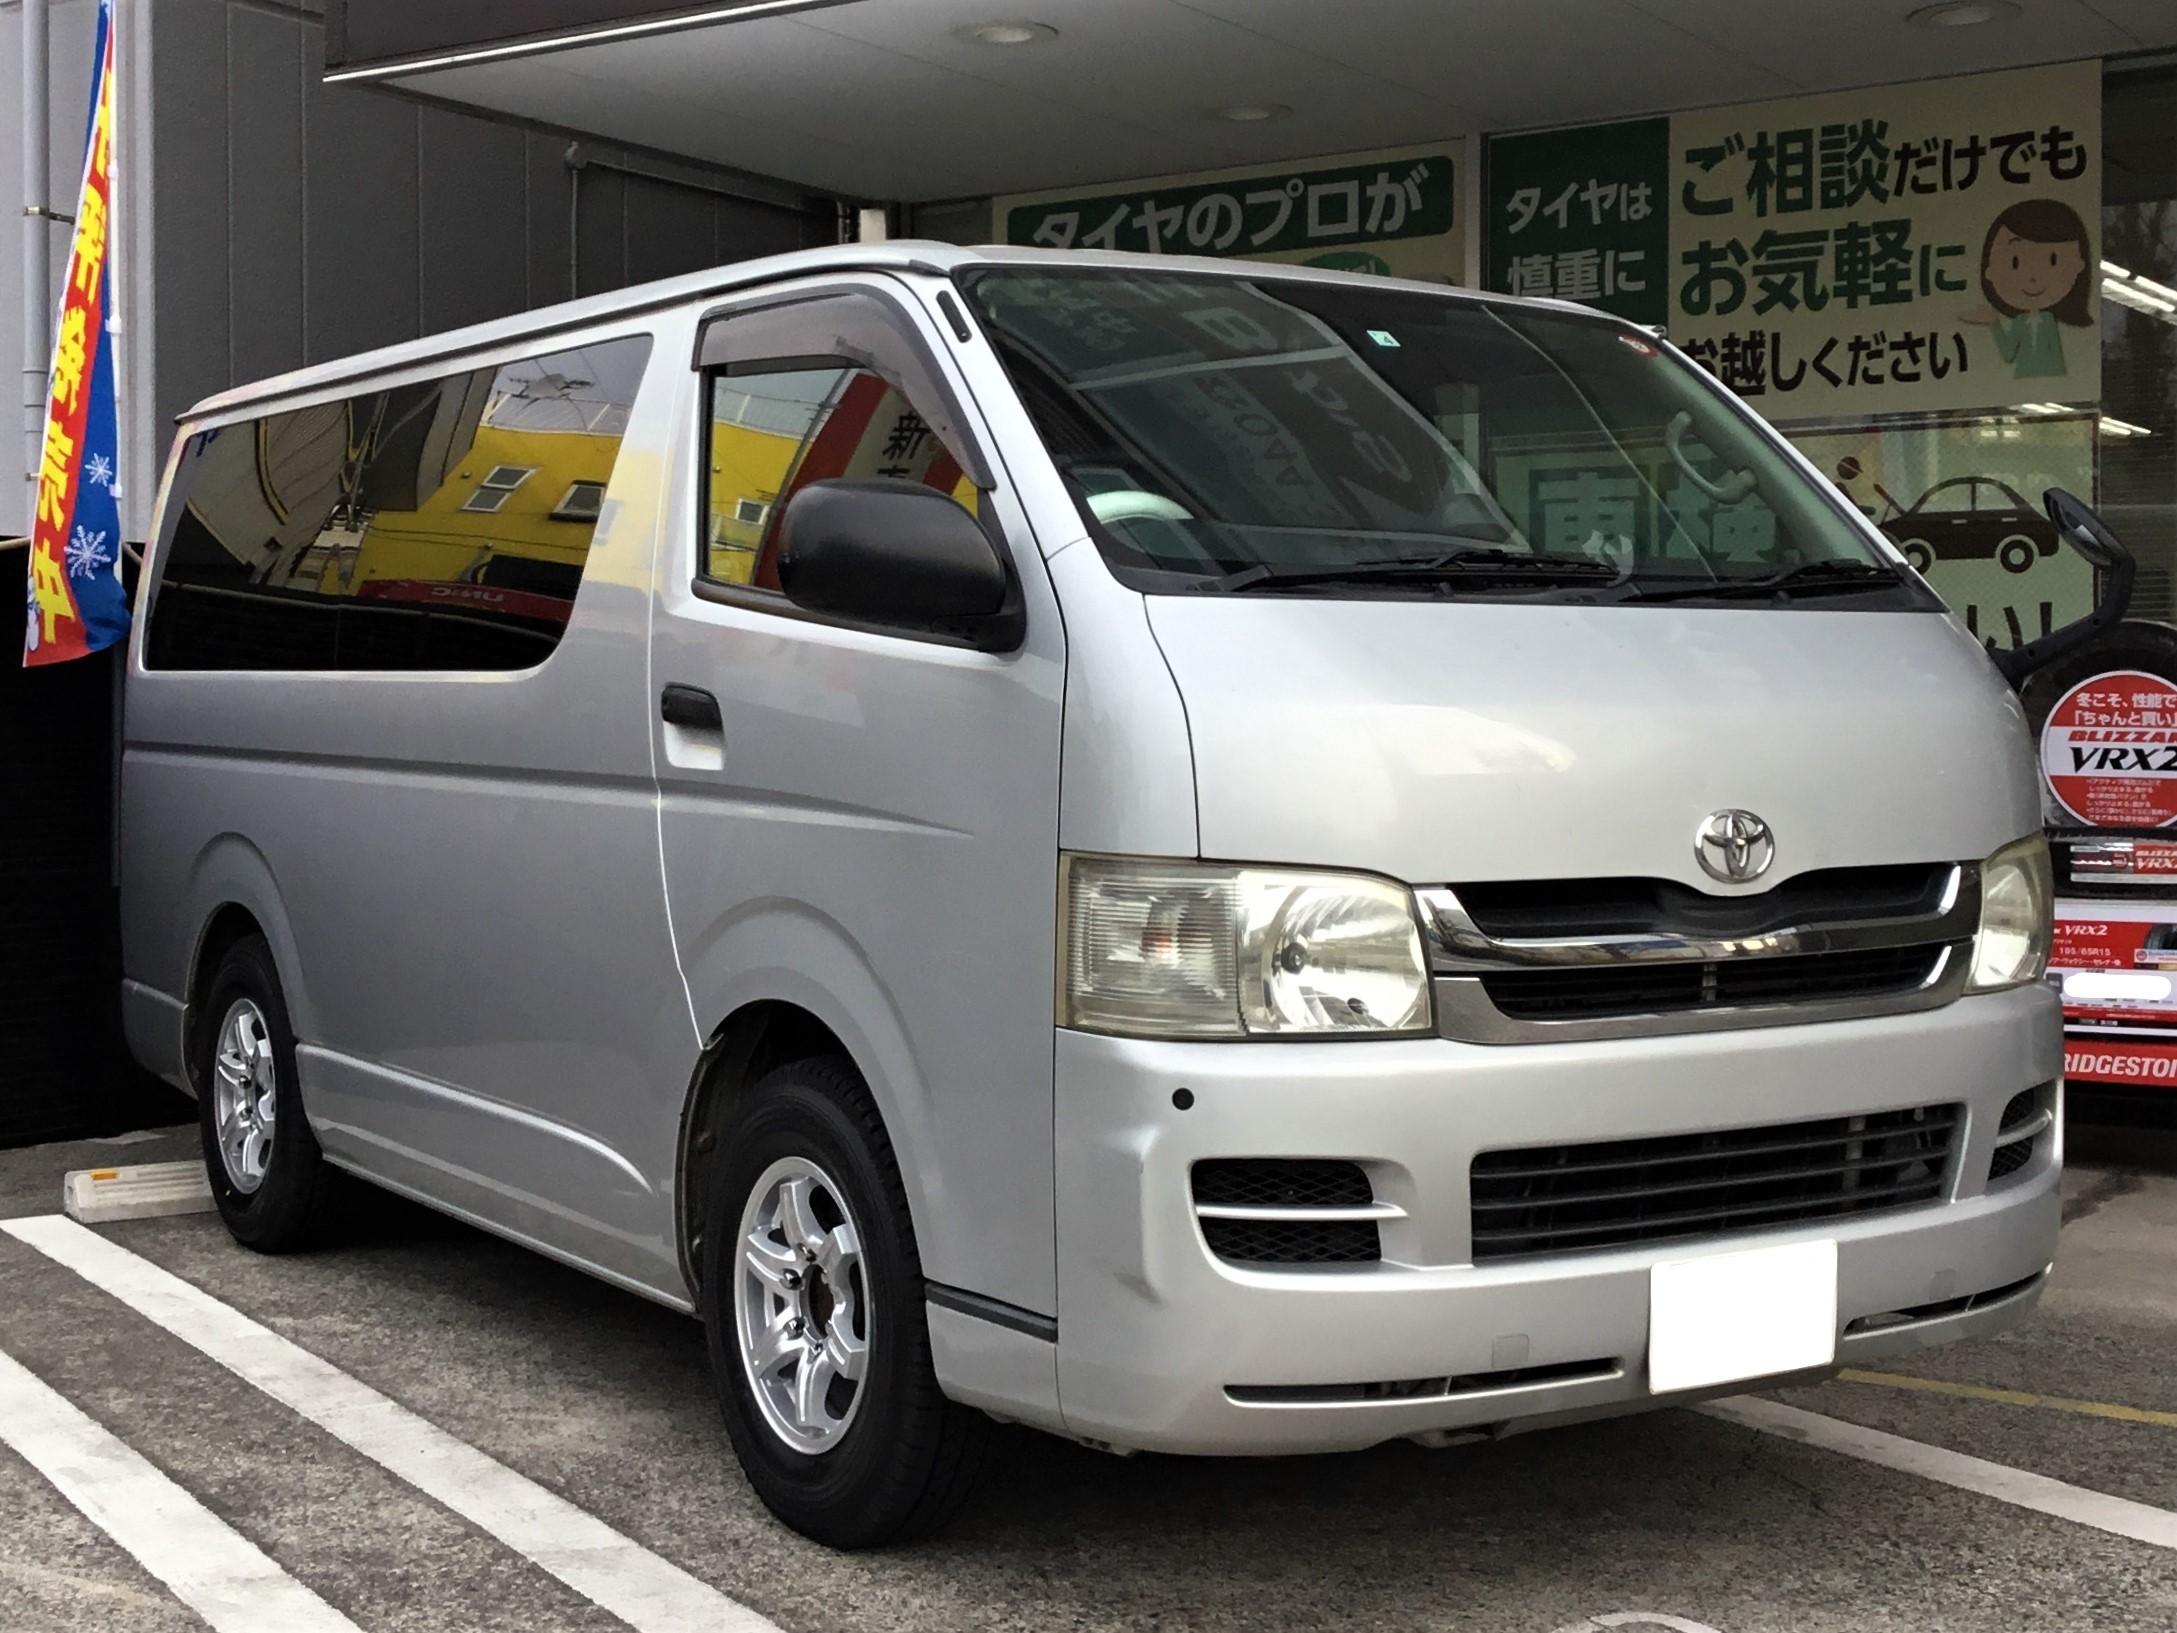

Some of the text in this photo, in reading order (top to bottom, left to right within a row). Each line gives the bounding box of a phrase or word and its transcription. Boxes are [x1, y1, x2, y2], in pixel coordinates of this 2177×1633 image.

[1681, 118, 2087, 218] ご相談だけでも
[1033, 162, 1430, 254] タイヤのプロが
[1506, 180, 1653, 234] タイヤは
[1507, 249, 1647, 301] 慎重に
[1680, 218, 1967, 317] お気軽に
[1681, 329, 1969, 397] お越しください
[2069, 745, 2177, 774] VRX2
[2065, 924, 2108, 936] VRX2
[2064, 1053, 2177, 1078] IDGESTO
